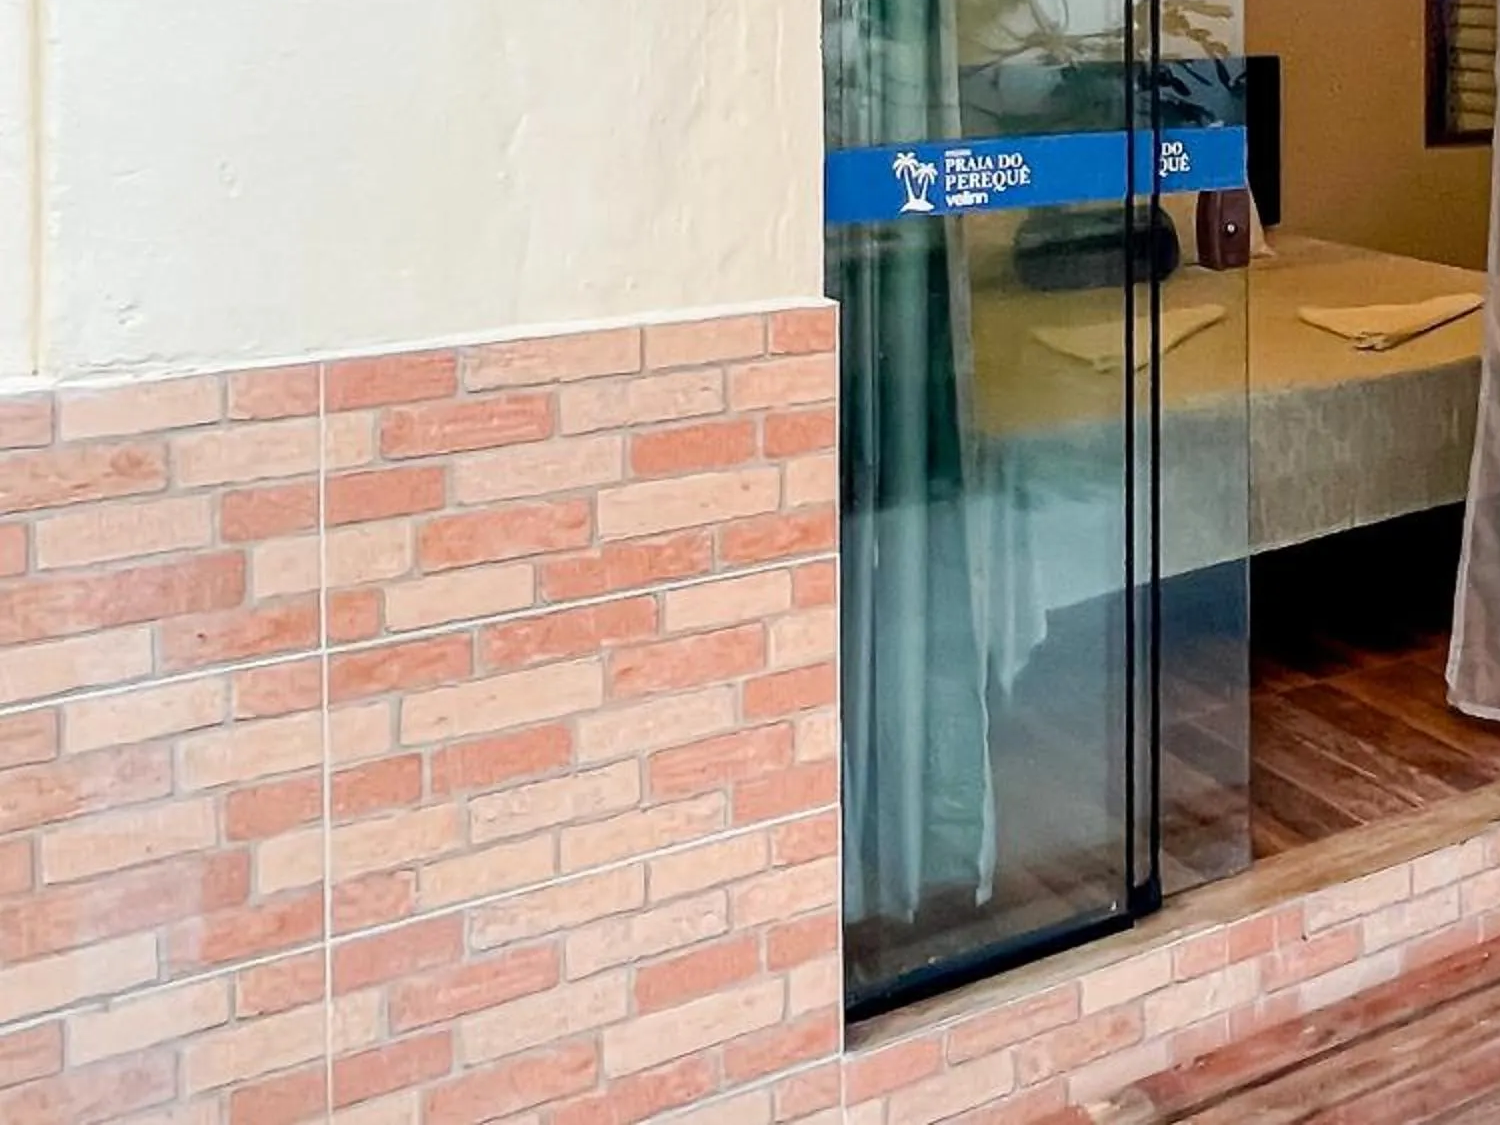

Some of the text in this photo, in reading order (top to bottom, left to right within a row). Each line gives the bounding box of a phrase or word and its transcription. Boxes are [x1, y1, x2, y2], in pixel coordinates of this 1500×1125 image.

[945, 152, 1023, 173] PRAIA DO
[945, 164, 1031, 192] PEREQUÊ
